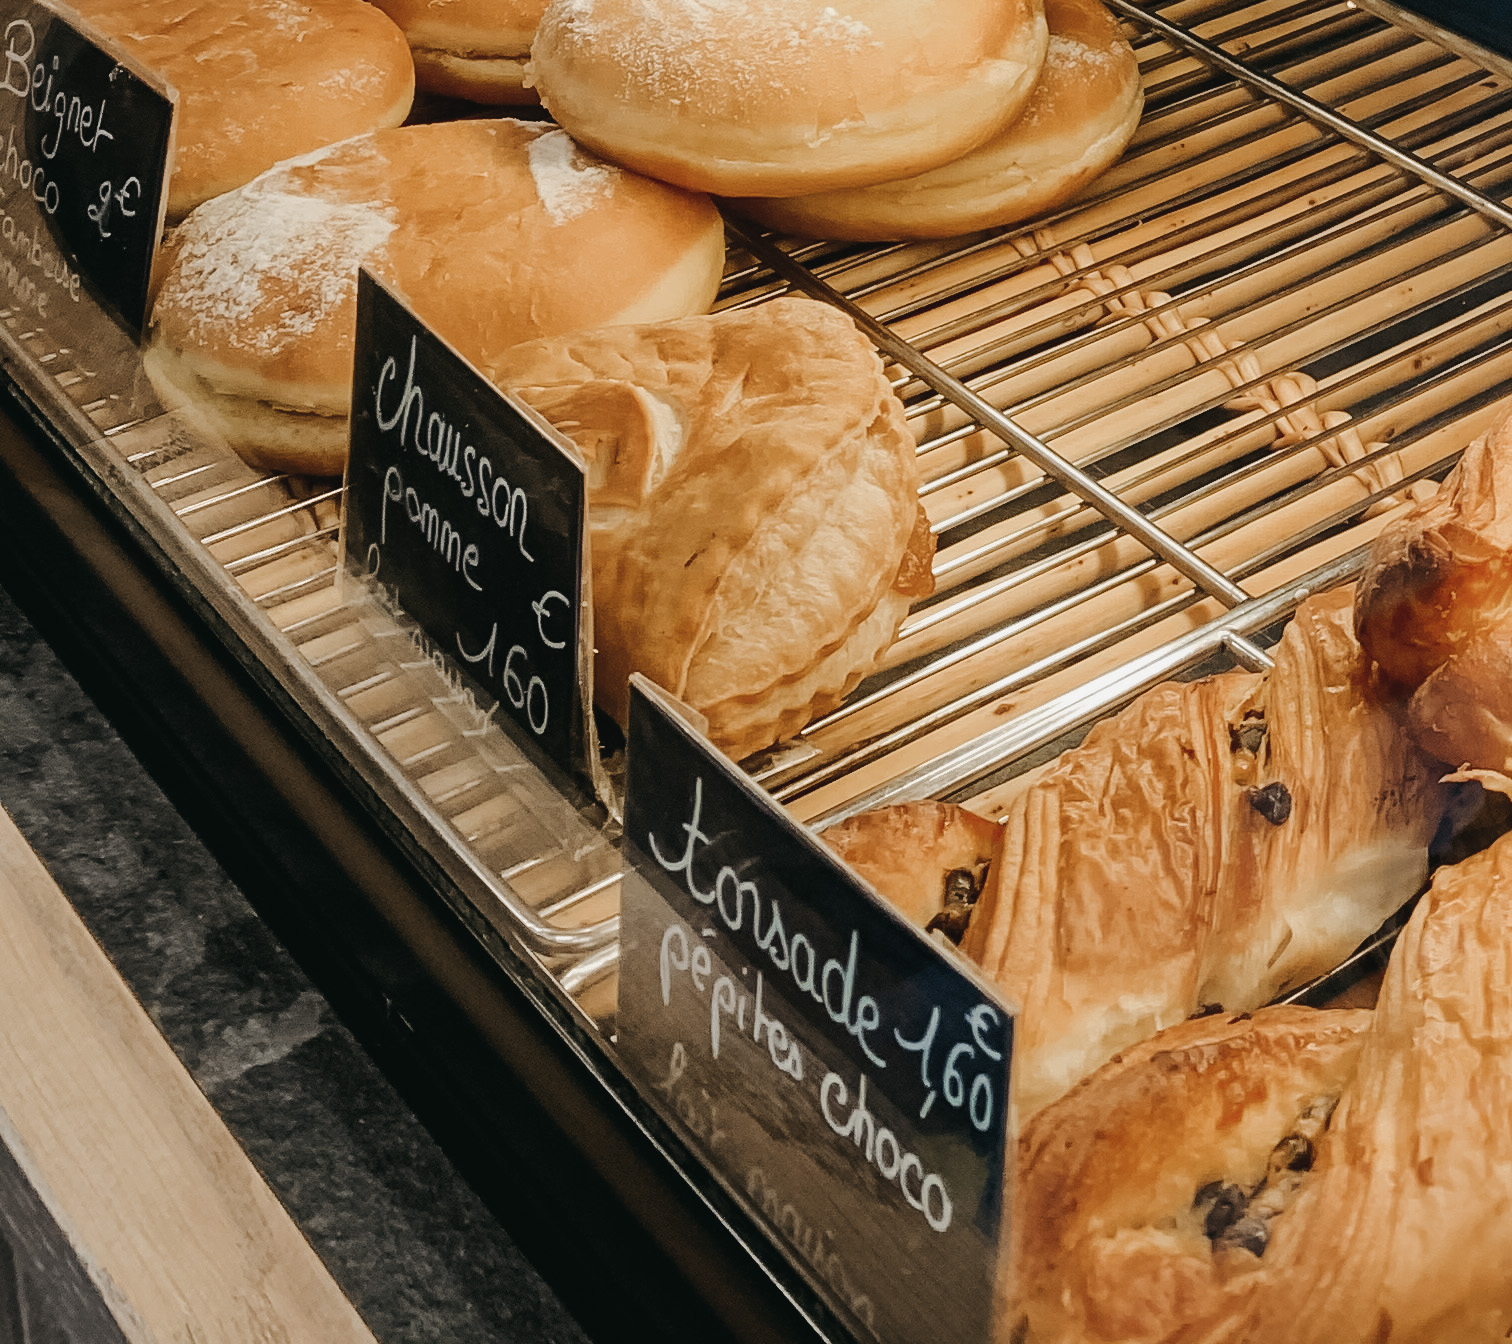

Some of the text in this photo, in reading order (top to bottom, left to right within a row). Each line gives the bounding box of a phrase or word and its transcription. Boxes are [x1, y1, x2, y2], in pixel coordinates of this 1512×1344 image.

[0, 19, 114, 159] Beignet
[0, 127, 60, 214] hoco
[381, 466, 482, 591] pomme
[648, 777, 886, 1069] torsade
[661, 924, 803, 1081] pépites
